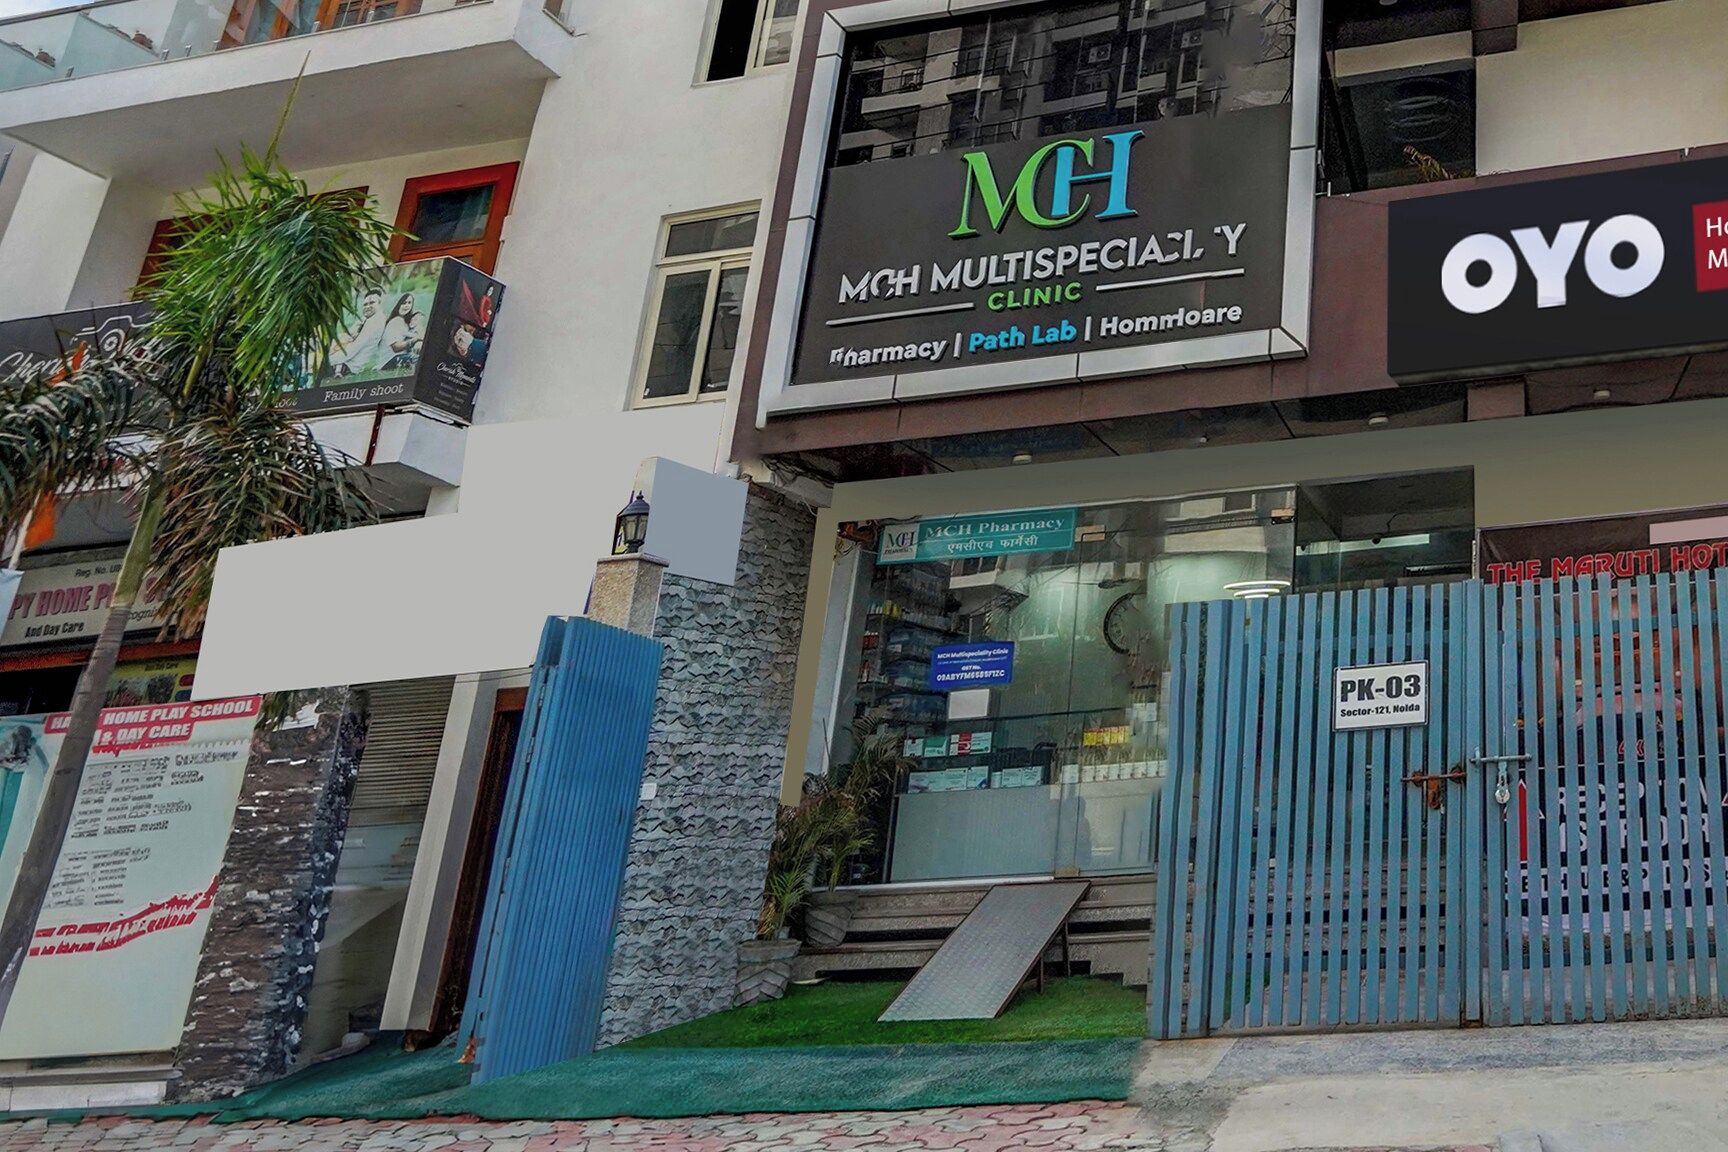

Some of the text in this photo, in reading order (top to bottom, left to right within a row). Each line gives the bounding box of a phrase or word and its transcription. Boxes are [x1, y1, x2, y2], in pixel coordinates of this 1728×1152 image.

[948, 130, 1144, 239] MCH
[1441, 214, 1665, 314] OYO
[986, 282, 1084, 312] CLINIC
[968, 329, 1026, 353] Path
[1030, 320, 1078, 347] Lab
[323, 383, 404, 403] Family shoot
[925, 518, 1065, 539] MCH Pharmacy
[1487, 559, 1542, 586] THE
[1551, 548, 1660, 584] MARUTI
[36, 584, 94, 617] HOME
[25, 621, 84, 638] And Day Care
[1340, 674, 1421, 703] PK-03
[103, 699, 254, 726] HOME PLAY SCHOOL
[1340, 704, 1420, 718] Sector-121, Noida
[115, 727, 146, 745] DAY
[150, 723, 192, 739] CARE
